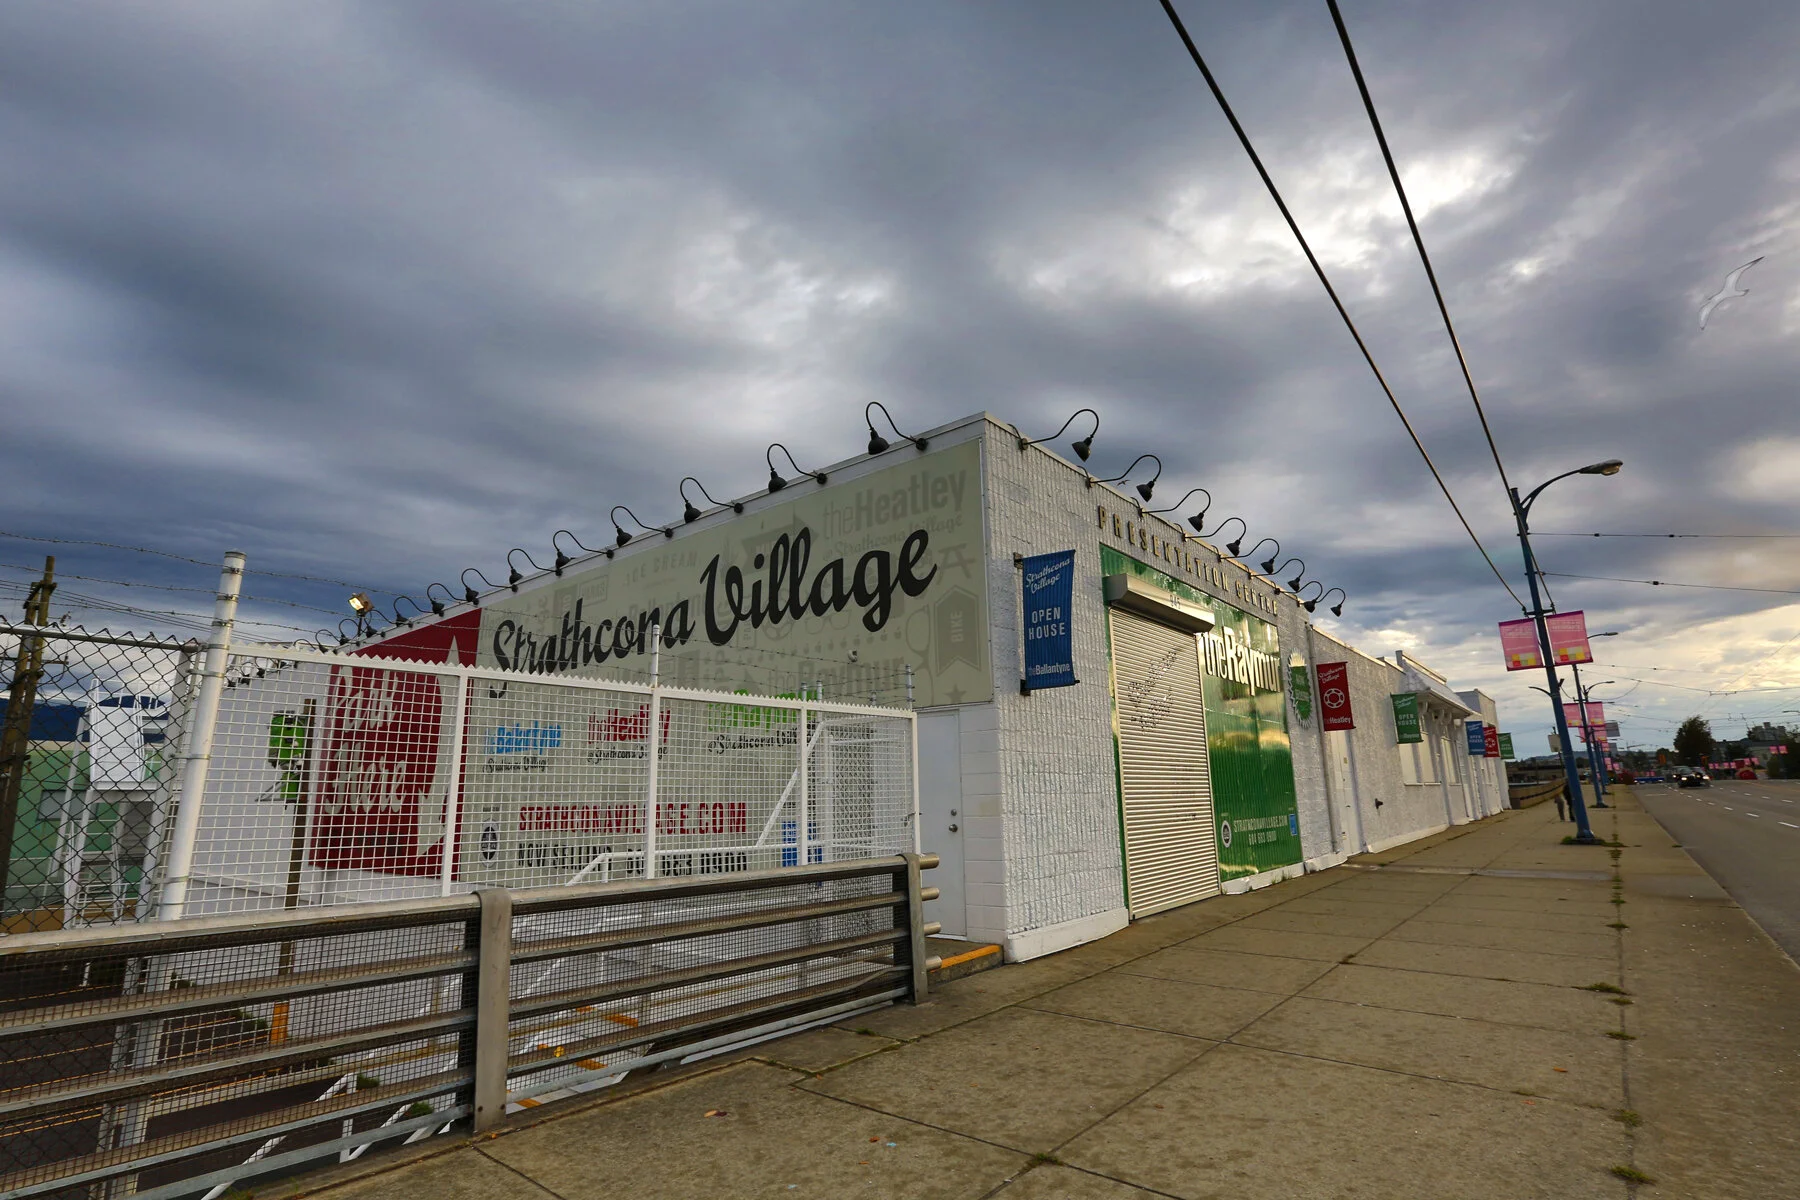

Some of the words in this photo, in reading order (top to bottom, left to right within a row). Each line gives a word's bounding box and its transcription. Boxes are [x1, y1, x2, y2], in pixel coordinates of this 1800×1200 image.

[1026, 558, 1071, 588] Strathcona
[1097, 504, 1229, 592] PRESENTATION
[1235, 579, 1278, 615] CENTRE
[1030, 573, 1061, 594] Village
[489, 597, 697, 699] Strathcona
[700, 526, 938, 647] Village
[950, 609, 964, 643] BIKE
[1031, 606, 1061, 624] OPEN
[1028, 622, 1066, 640] HOUSE
